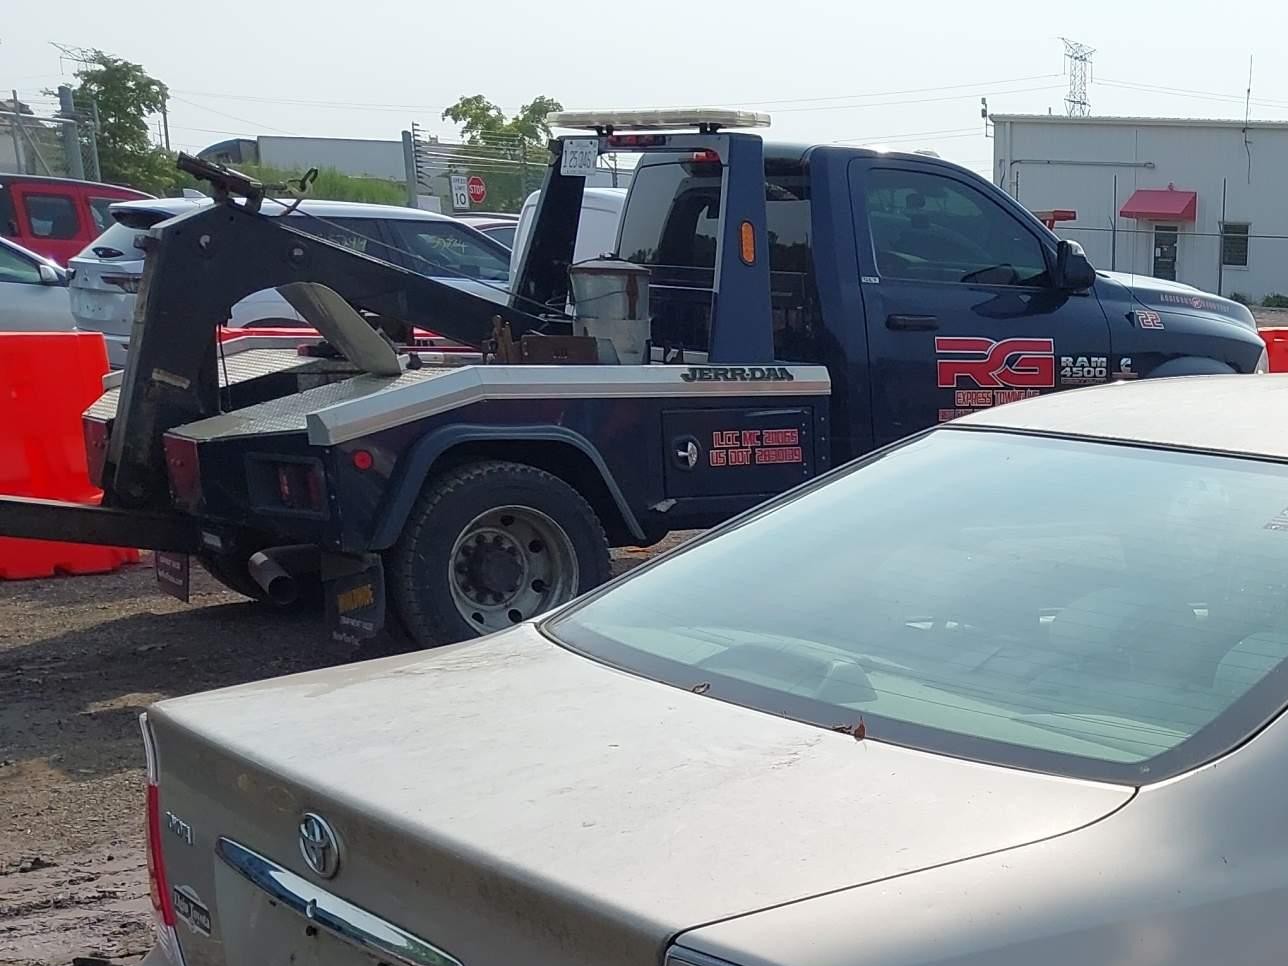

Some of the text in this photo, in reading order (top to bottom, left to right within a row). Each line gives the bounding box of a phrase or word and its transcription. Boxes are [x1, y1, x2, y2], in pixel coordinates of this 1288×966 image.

[469, 184, 484, 195] STOP
[455, 192, 467, 206] 10
[1136, 310, 1165, 330] 22
[935, 336, 1055, 388] RG
[1060, 356, 1108, 367] RAM
[1060, 367, 1108, 378] 4500
[955, 390, 993, 407] EXPRESS
[742, 430, 761, 447] MC
[709, 449, 727, 467] US
[728, 447, 752, 466] DOT
